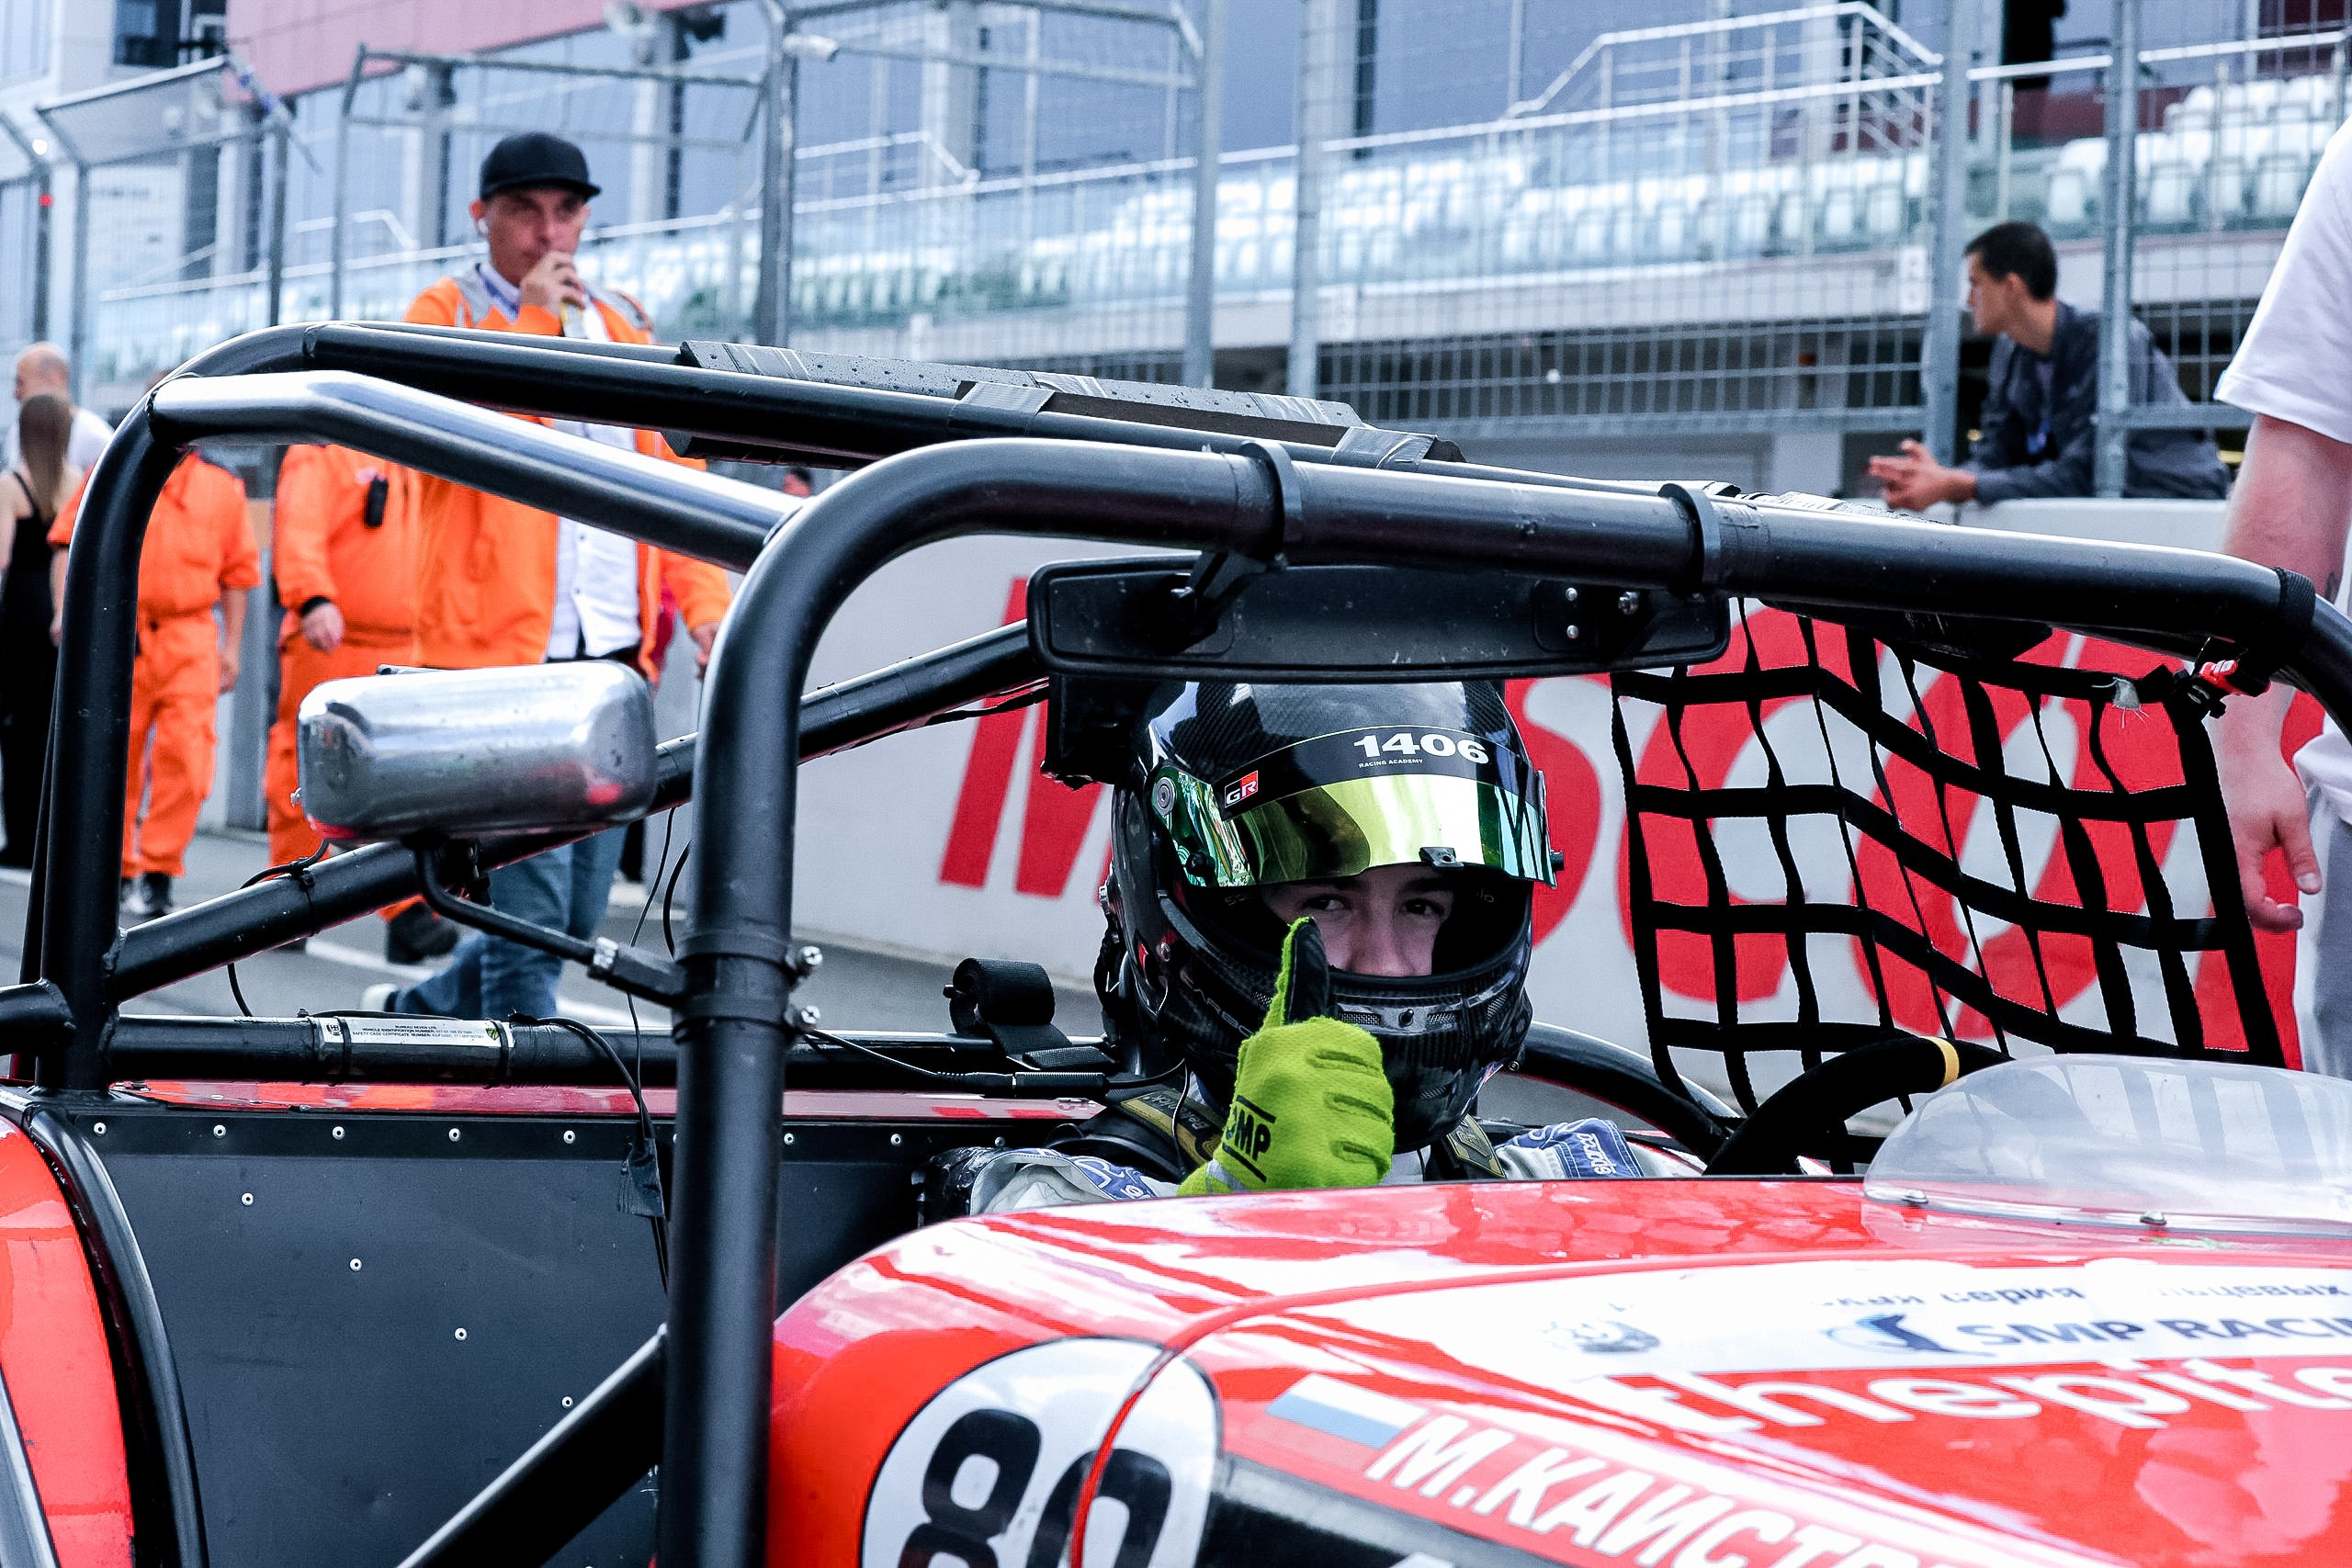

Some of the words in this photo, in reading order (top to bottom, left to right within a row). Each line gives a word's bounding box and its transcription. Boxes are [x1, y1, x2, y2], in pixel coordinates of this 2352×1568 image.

[1353, 732, 1489, 764] 1406
[1358, 760, 1387, 768] RACING
[1226, 779, 1258, 805] GR
[1575, 1132, 1618, 1176] sparco
[1956, 1319, 2145, 1345] SMP
[897, 1407, 1173, 1568] 80
